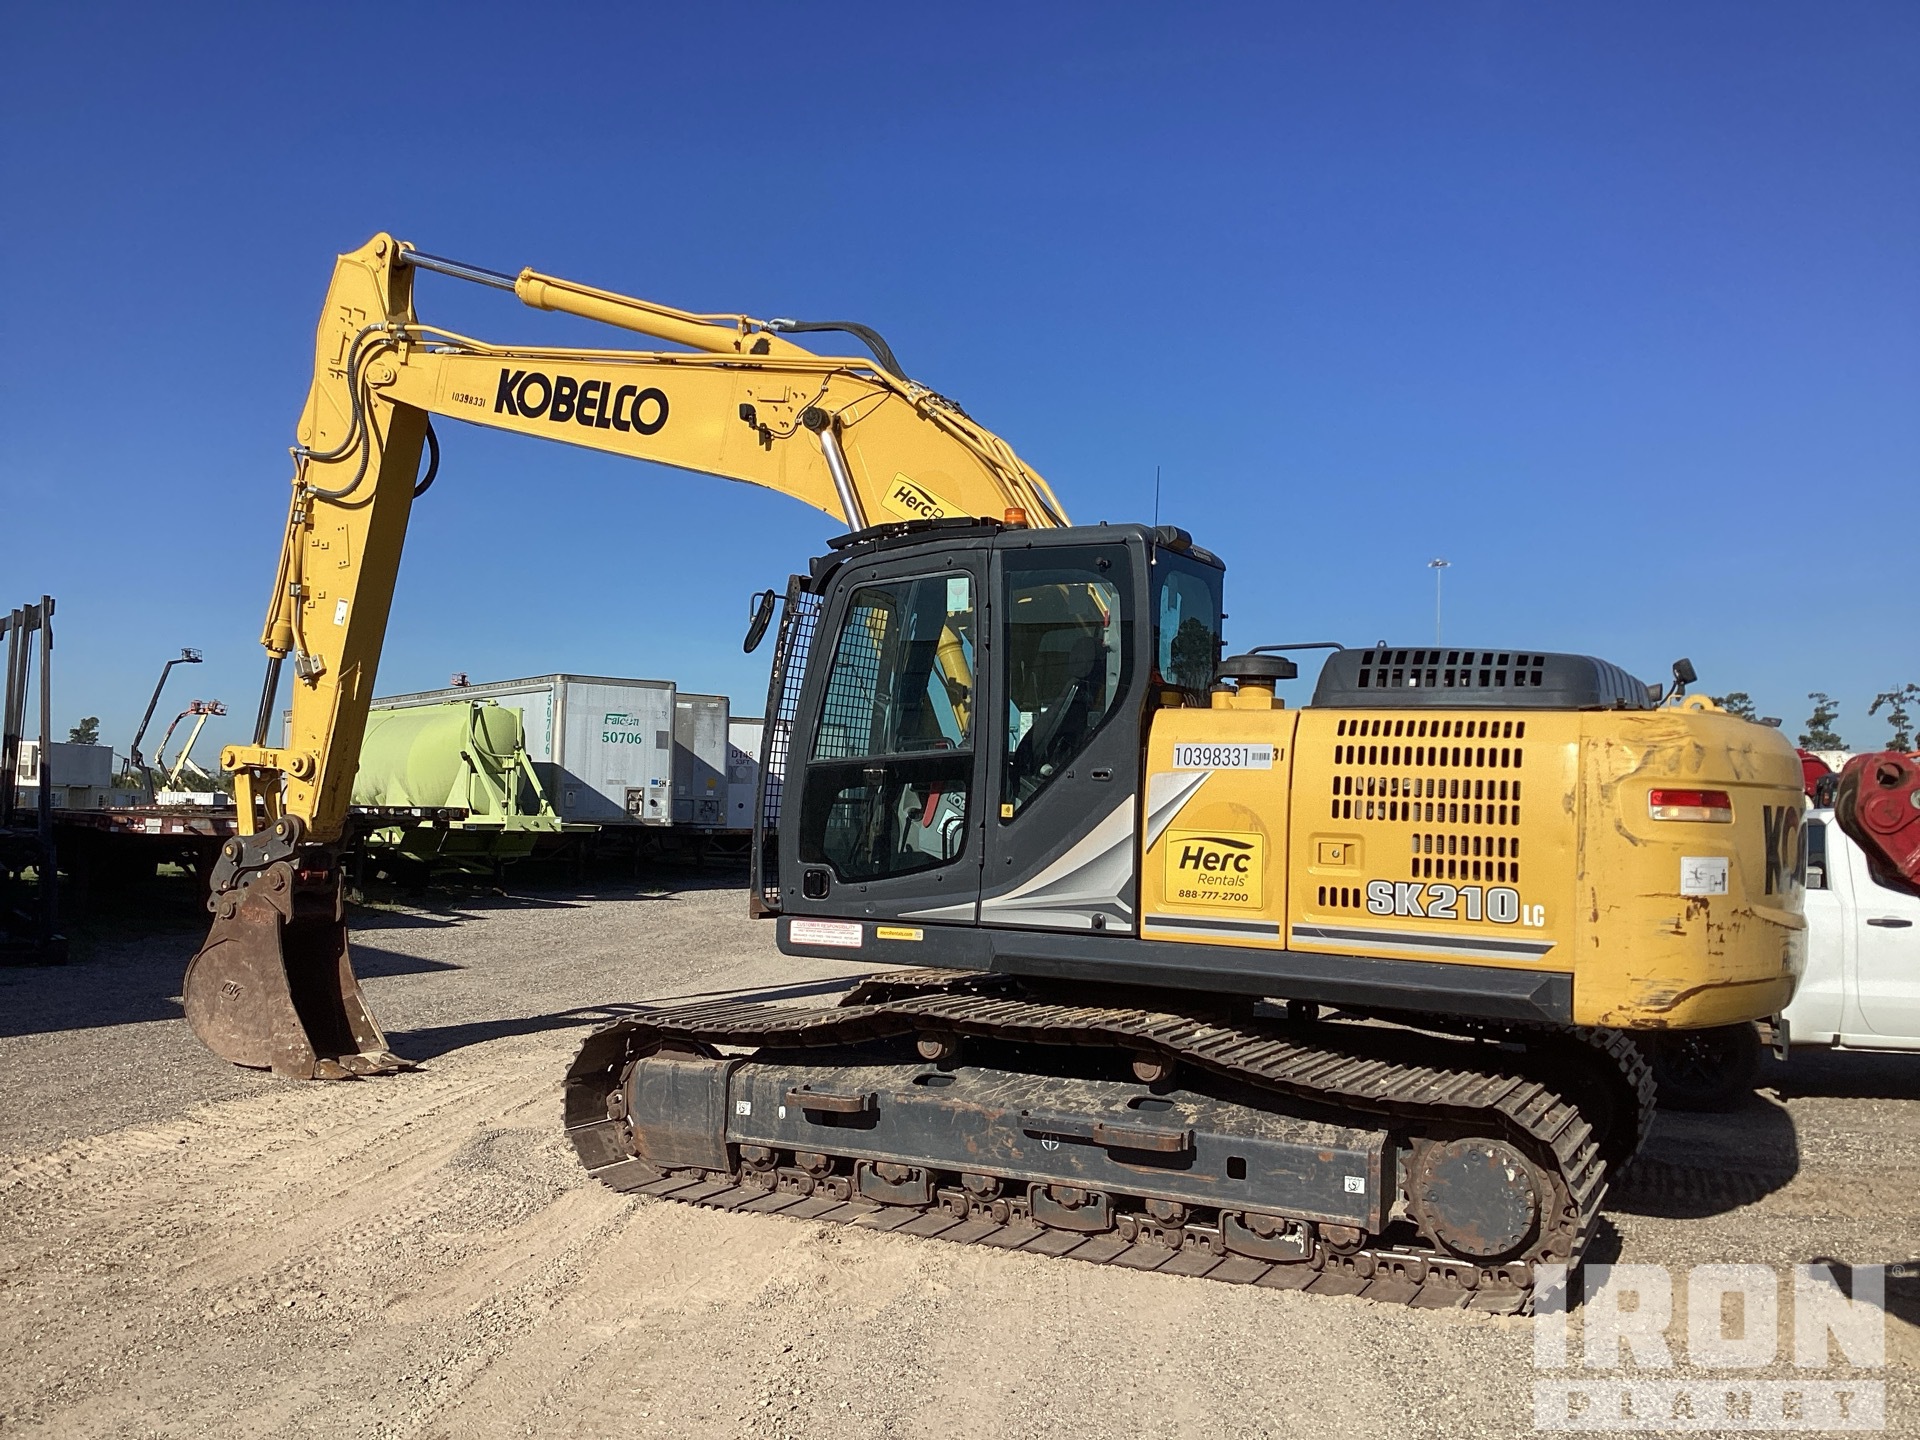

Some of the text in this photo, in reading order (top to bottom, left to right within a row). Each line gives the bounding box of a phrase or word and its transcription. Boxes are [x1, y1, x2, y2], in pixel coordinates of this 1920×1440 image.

[451, 391, 486, 407] 10398331
[494, 368, 669, 435] KOBELCO
[602, 731, 642, 745] 50706
[1175, 747, 1249, 766] 10398331
[1179, 846, 1251, 873] Herc
[1178, 889, 1249, 902] 888-777-2700
[1367, 880, 1545, 927] SK210 LC
